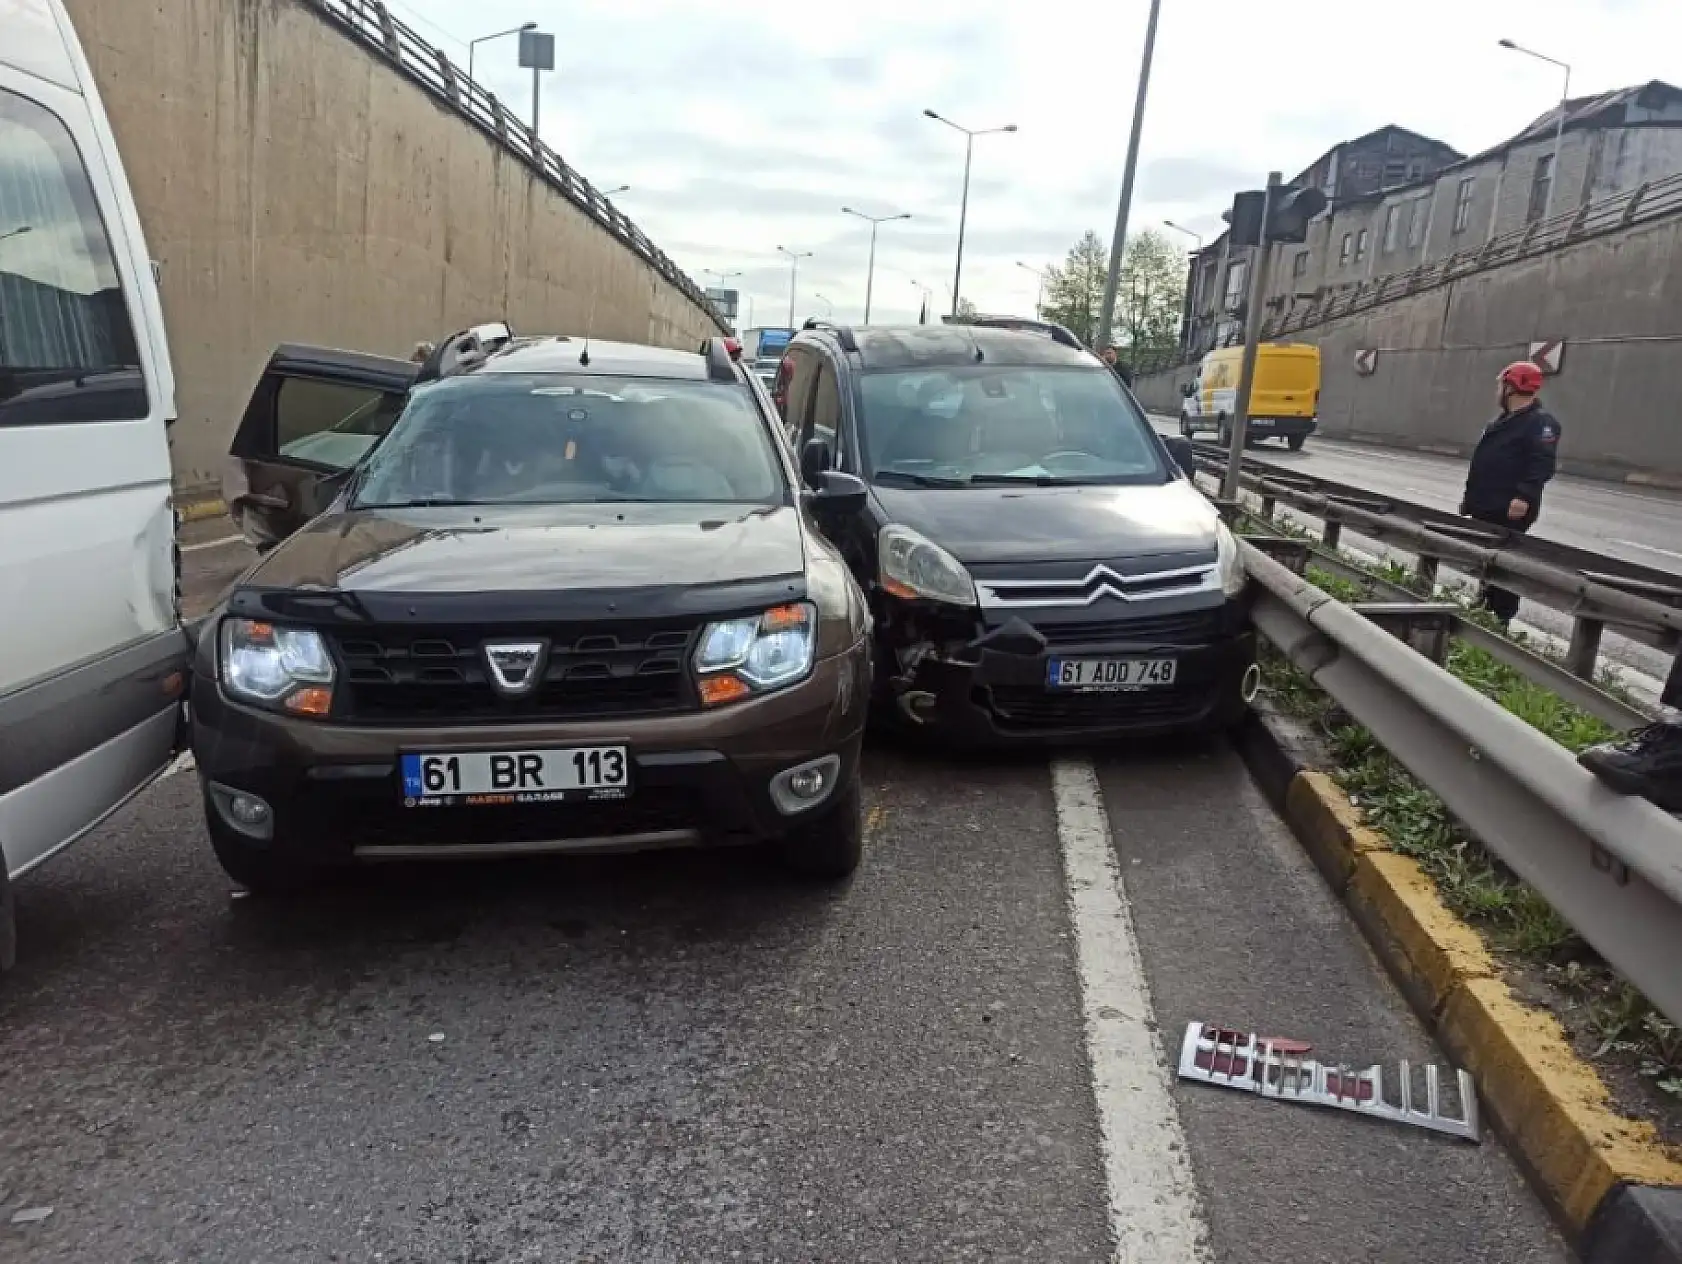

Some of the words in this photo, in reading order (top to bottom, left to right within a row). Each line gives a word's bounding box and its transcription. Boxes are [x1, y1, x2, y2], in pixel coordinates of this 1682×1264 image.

[1062, 662, 1082, 682] 61
[1137, 661, 1173, 682] 748
[423, 756, 460, 791] 61
[489, 754, 544, 789] BR
[572, 750, 624, 785] 113
